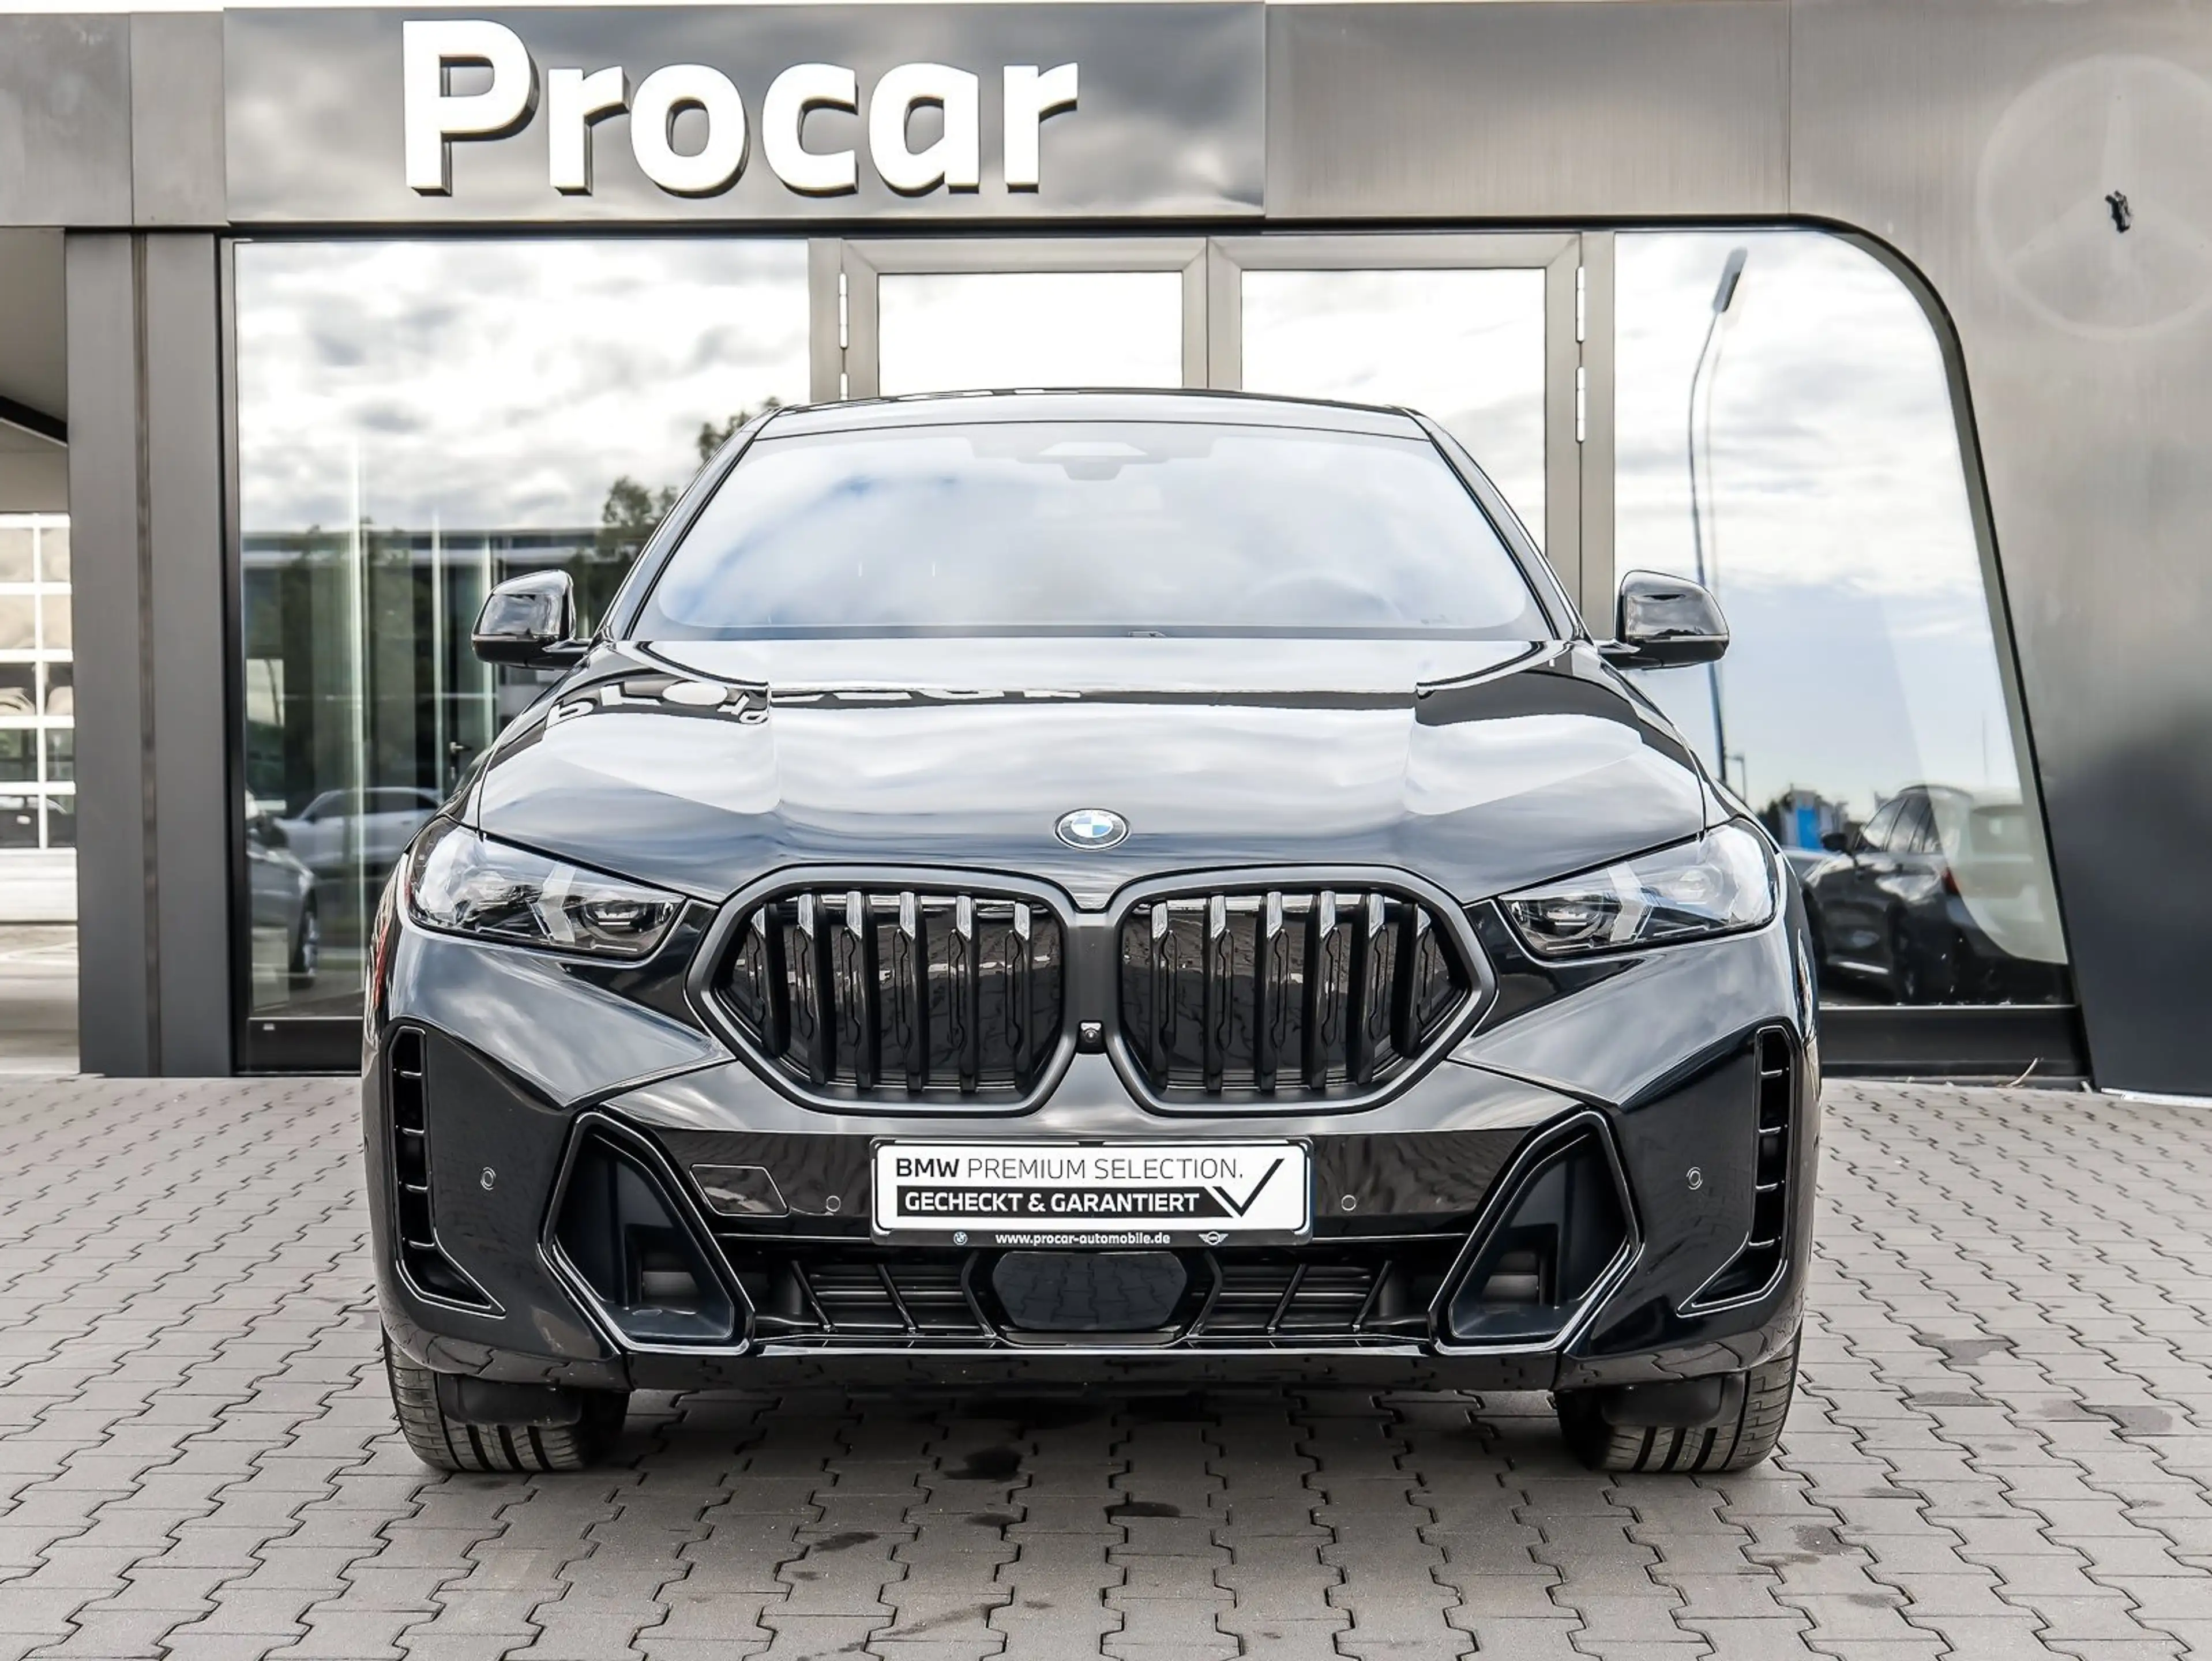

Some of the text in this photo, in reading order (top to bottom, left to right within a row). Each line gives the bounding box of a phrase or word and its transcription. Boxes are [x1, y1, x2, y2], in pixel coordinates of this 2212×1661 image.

[403, 20, 1079, 198] Procar
[896, 1158, 1243, 1179] BMW PREMIUM SELECTION.
[905, 1191, 1200, 1212] GECHECKT & GARANTIERT
[995, 1232, 1170, 1246] www.procar-automobile.de
